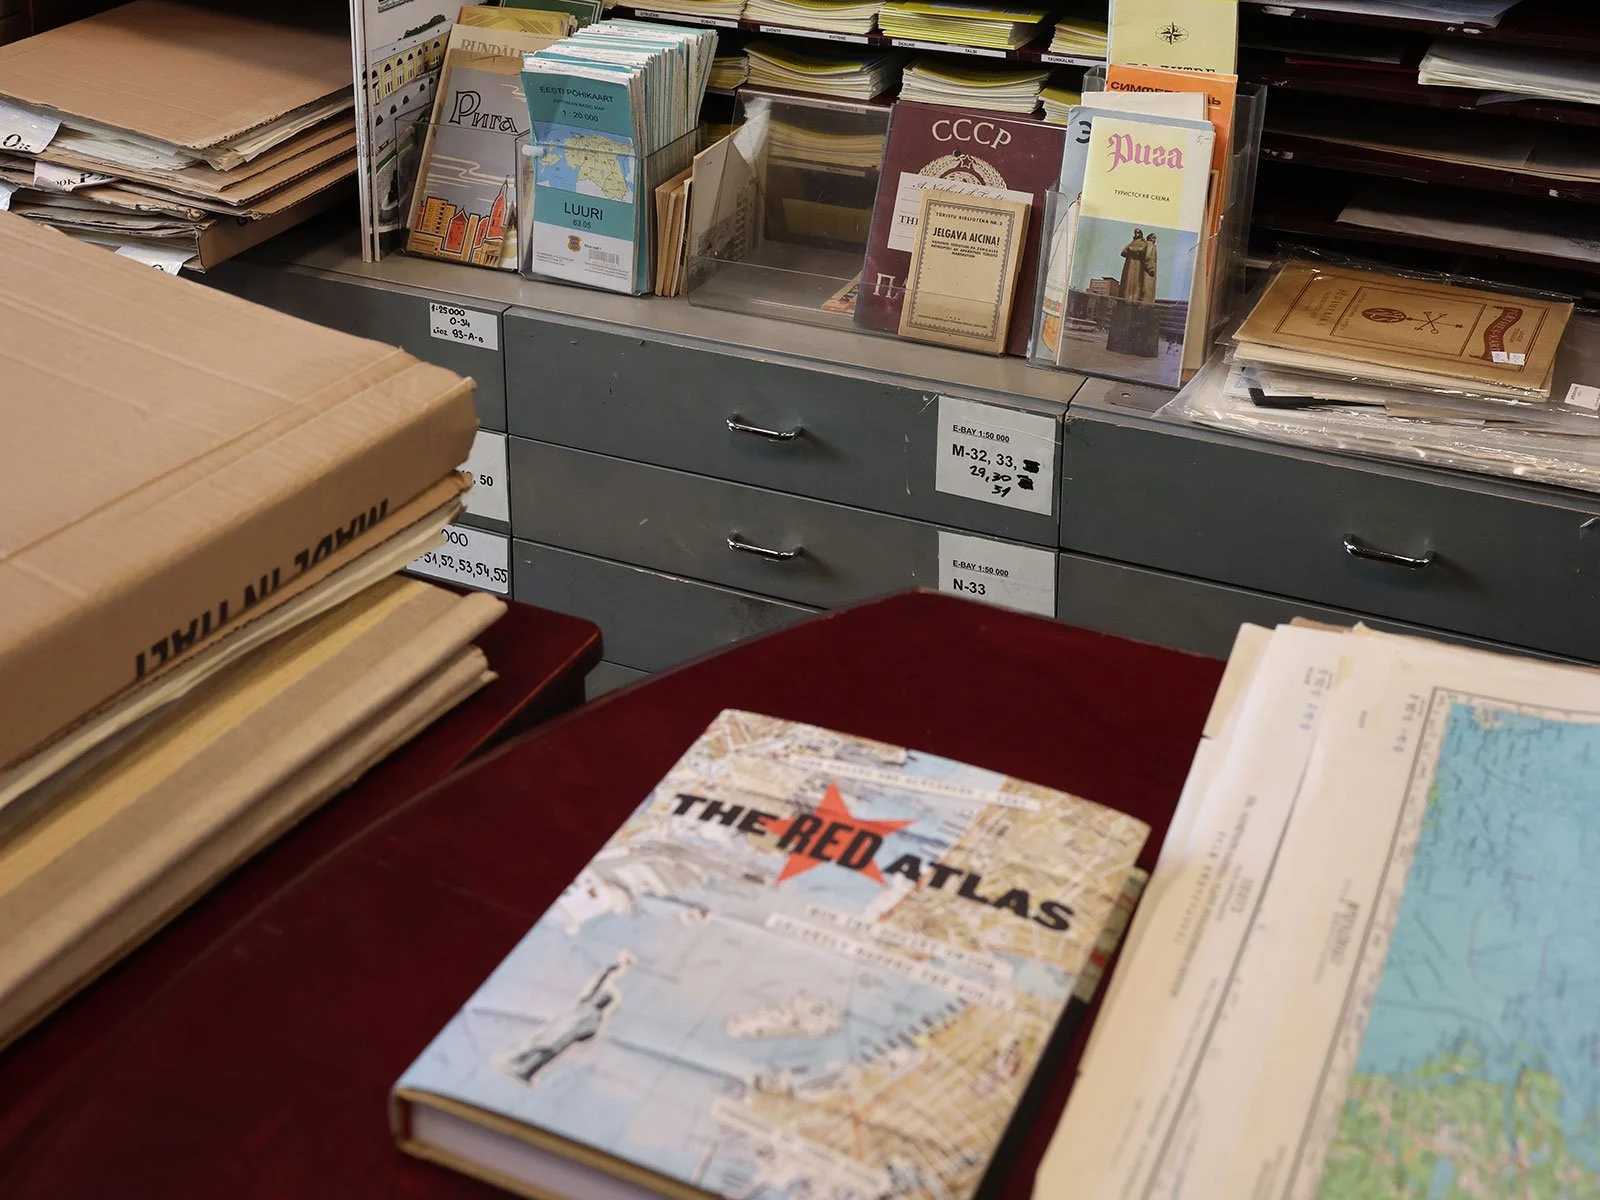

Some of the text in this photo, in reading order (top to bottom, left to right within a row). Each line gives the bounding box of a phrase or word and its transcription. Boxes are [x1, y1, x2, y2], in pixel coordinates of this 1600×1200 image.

[540, 86, 614, 103] EESTI PÕHIKAART
[450, 90, 518, 133] Рига
[574, 112, 583, 120] 20
[584, 113, 599, 122] 000
[932, 118, 1012, 149] СССР
[1107, 133, 1184, 173] Рига
[1114, 189, 1170, 202] ТУРИСТСКАЯ СХЕМА
[564, 202, 603, 220] LUURI
[933, 227, 1000, 246] JELGAVA AICINA!
[952, 424, 1010, 443] E-BAY 1:50 000
[952, 443, 1017, 470] M-32, 33,
[480, 475, 494, 486] 50
[953, 560, 1009, 578] E-BAY 1:50 000
[953, 578, 986, 595] N-33
[672, 793, 1077, 932] THE RED ATLAS
